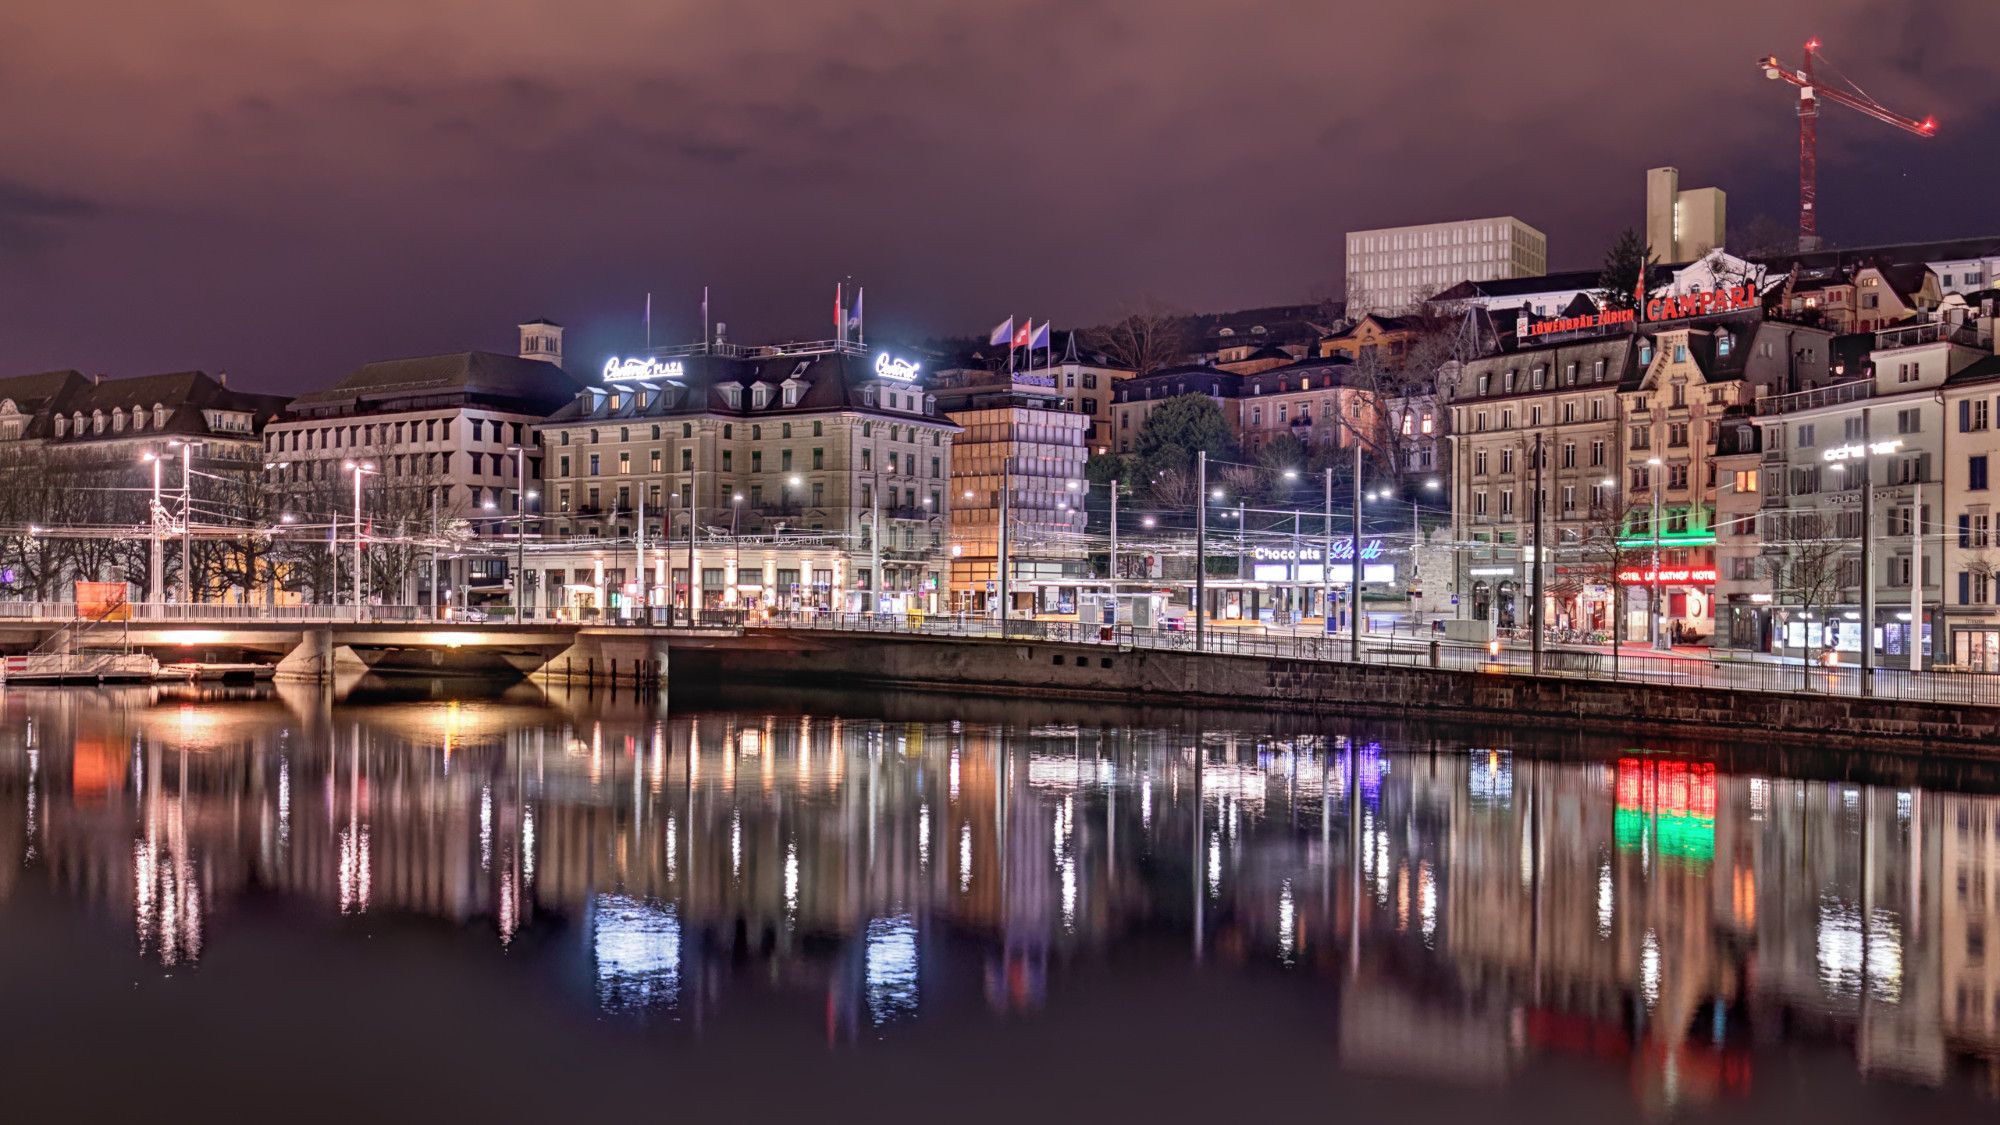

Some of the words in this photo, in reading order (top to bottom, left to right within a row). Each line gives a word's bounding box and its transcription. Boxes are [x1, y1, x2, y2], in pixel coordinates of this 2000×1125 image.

[1646, 284, 1757, 321] CAMPARI
[1531, 314, 1593, 336] LÖWENBRÄU
[1597, 308, 1634, 326] ZÜRICH
[604, 357, 655, 380] Central
[654, 361, 683, 375] PLAZA
[876, 353, 920, 380] Central
[1255, 547, 1321, 560] Chocoats
[1617, 571, 1641, 581] OTEL
